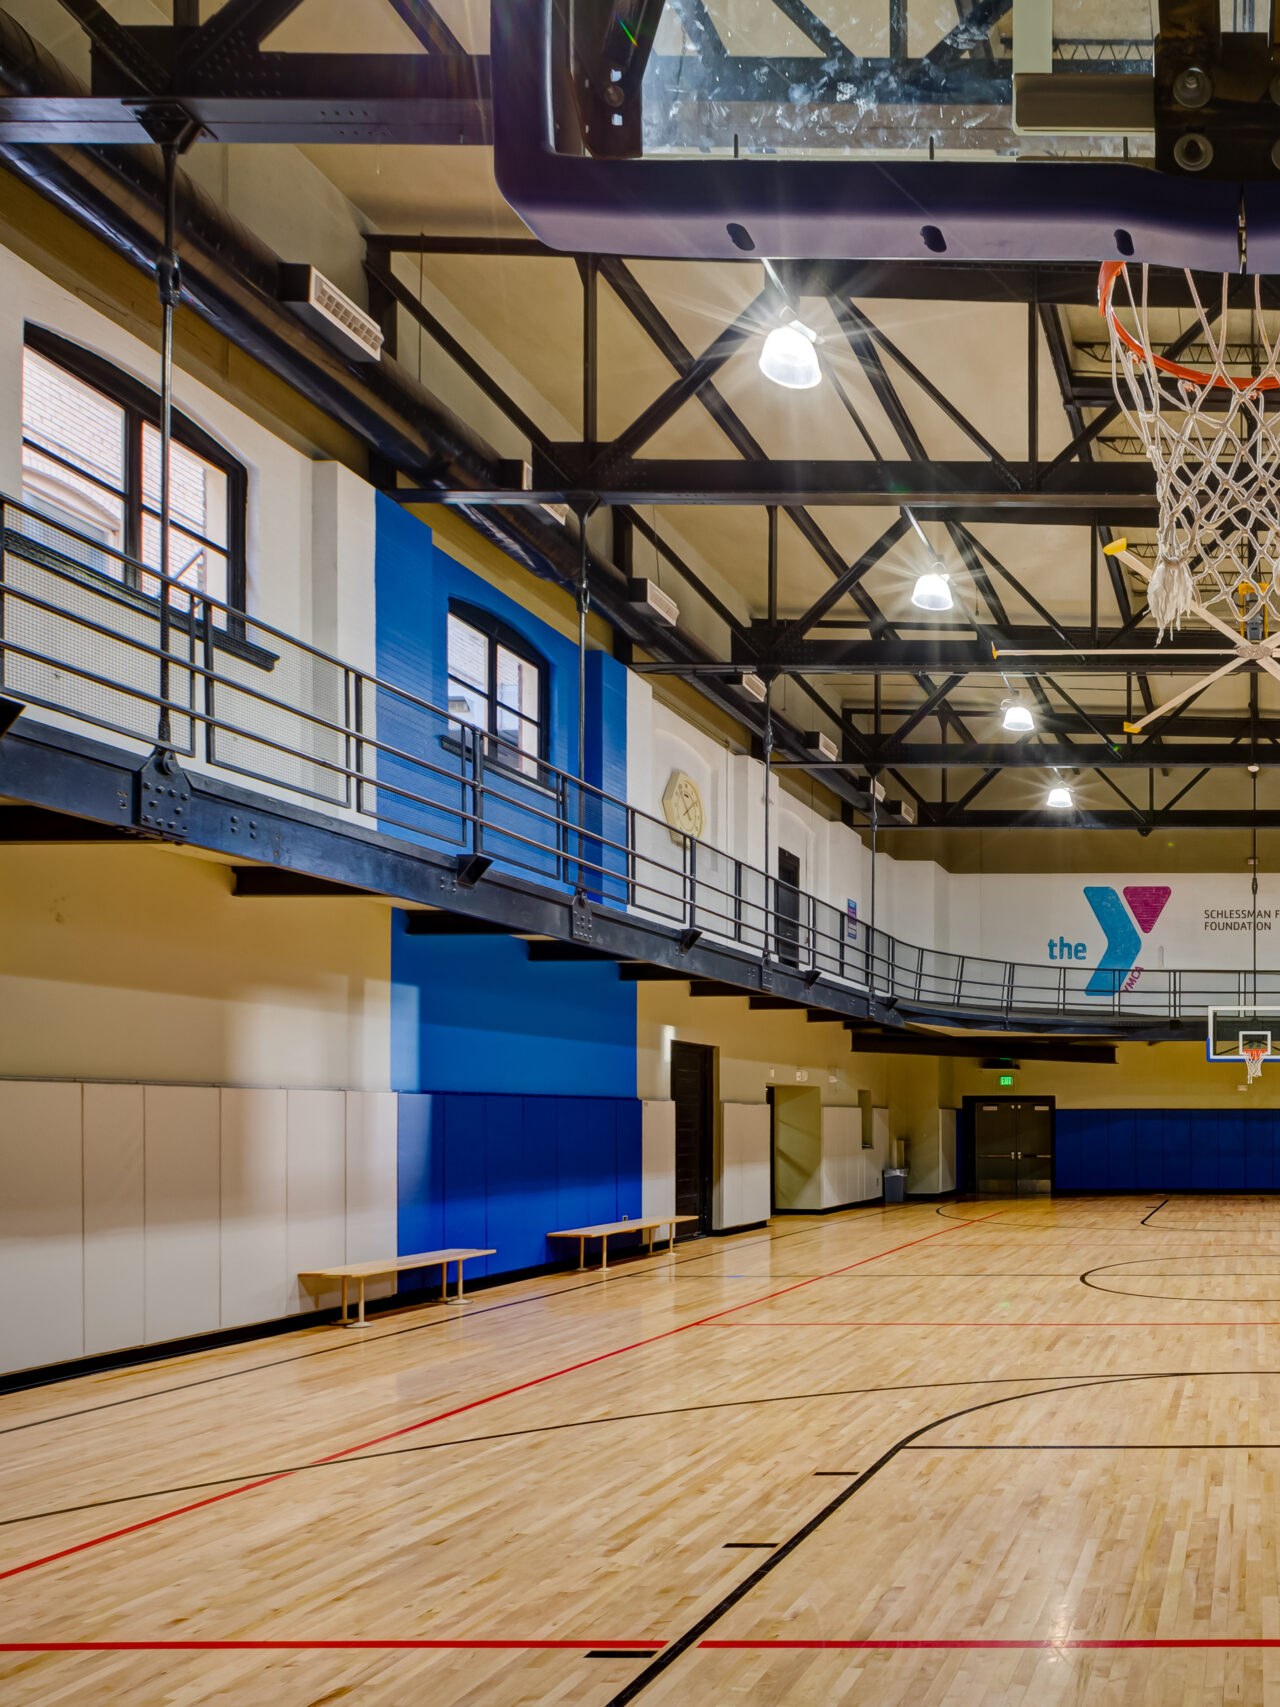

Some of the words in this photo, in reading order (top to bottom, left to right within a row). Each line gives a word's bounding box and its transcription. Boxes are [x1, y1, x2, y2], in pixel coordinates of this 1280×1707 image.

[1204, 909, 1272, 919] SCHLESSMAN
[1204, 921, 1272, 931] FOUNDATON
[1047, 935, 1087, 960] the
[1000, 1076, 1012, 1086] EXIT
